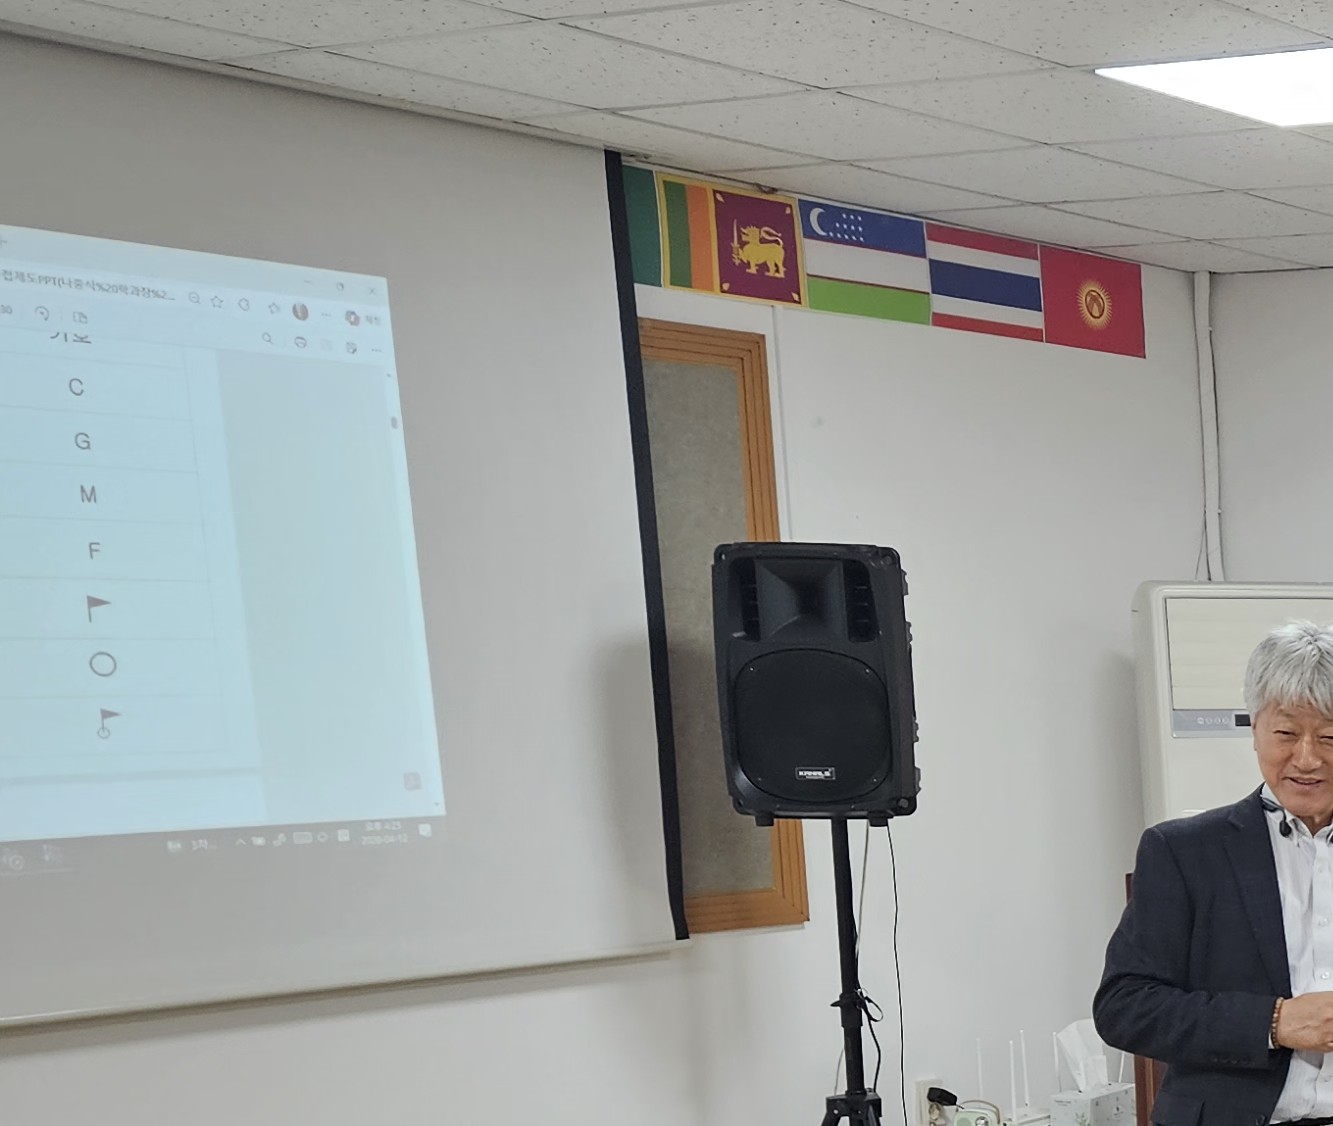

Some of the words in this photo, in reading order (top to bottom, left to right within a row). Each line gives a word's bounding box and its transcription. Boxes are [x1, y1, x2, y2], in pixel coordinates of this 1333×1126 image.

[69, 379, 85, 396] C
[74, 433, 91, 450] G
[80, 485, 97, 503] M
[89, 542, 101, 559] F
